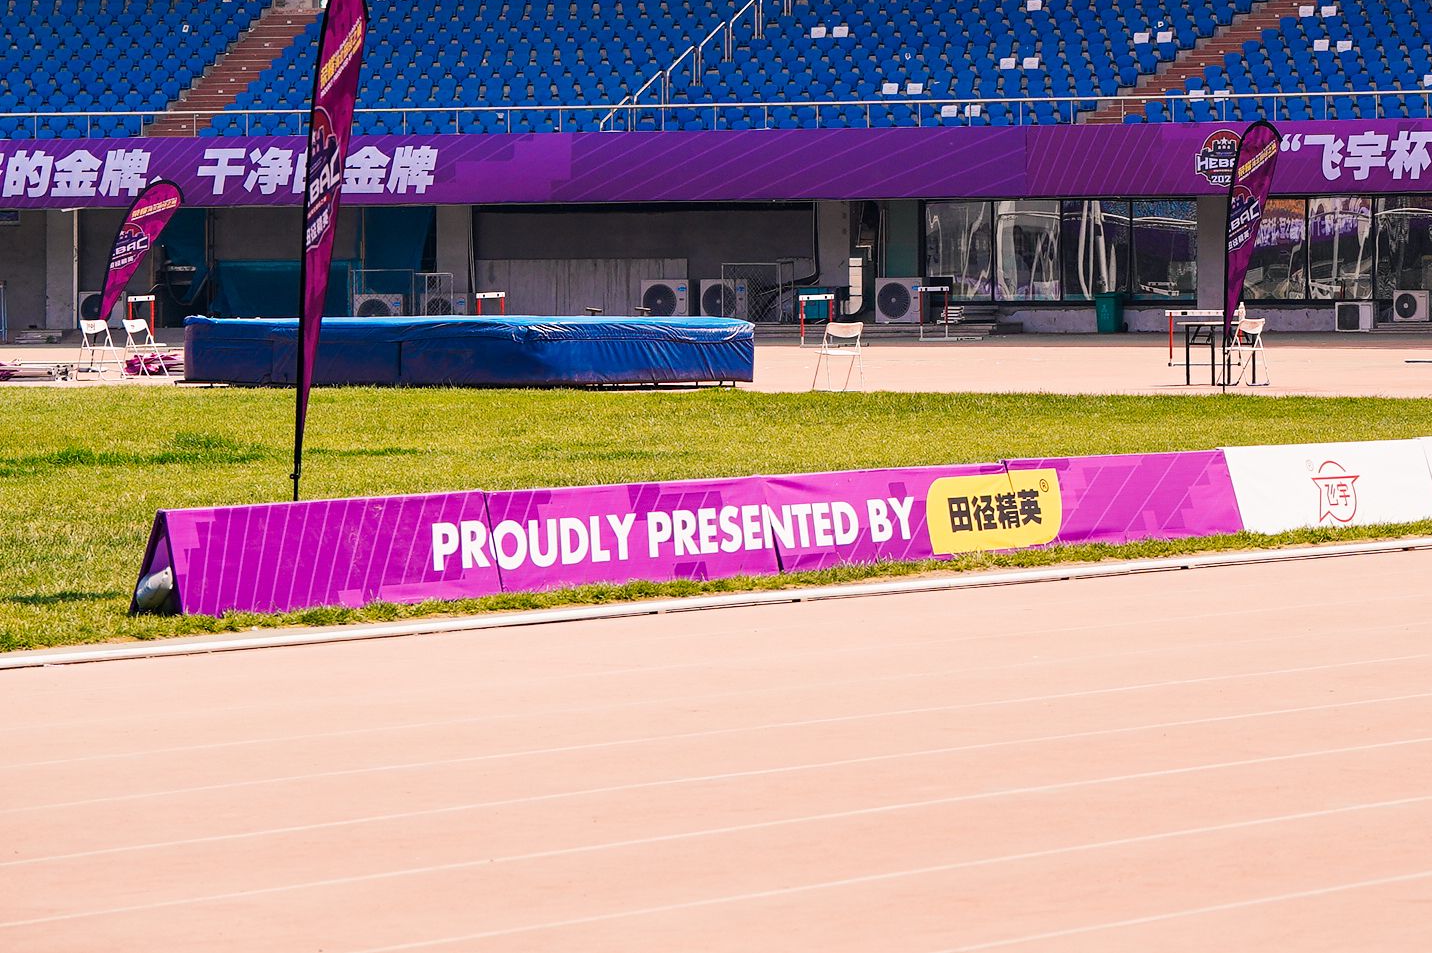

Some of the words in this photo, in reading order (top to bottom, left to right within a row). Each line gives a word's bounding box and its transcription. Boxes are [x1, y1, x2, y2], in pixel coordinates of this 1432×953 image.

[0, 148, 163, 197] 的金牌
[1211, 175, 1231, 183] 202
[432, 513, 636, 572] PROUDLY
[648, 501, 860, 559] PRESENTED
[870, 496, 915, 544] BY
[948, 489, 1042, 534] 田径精英
